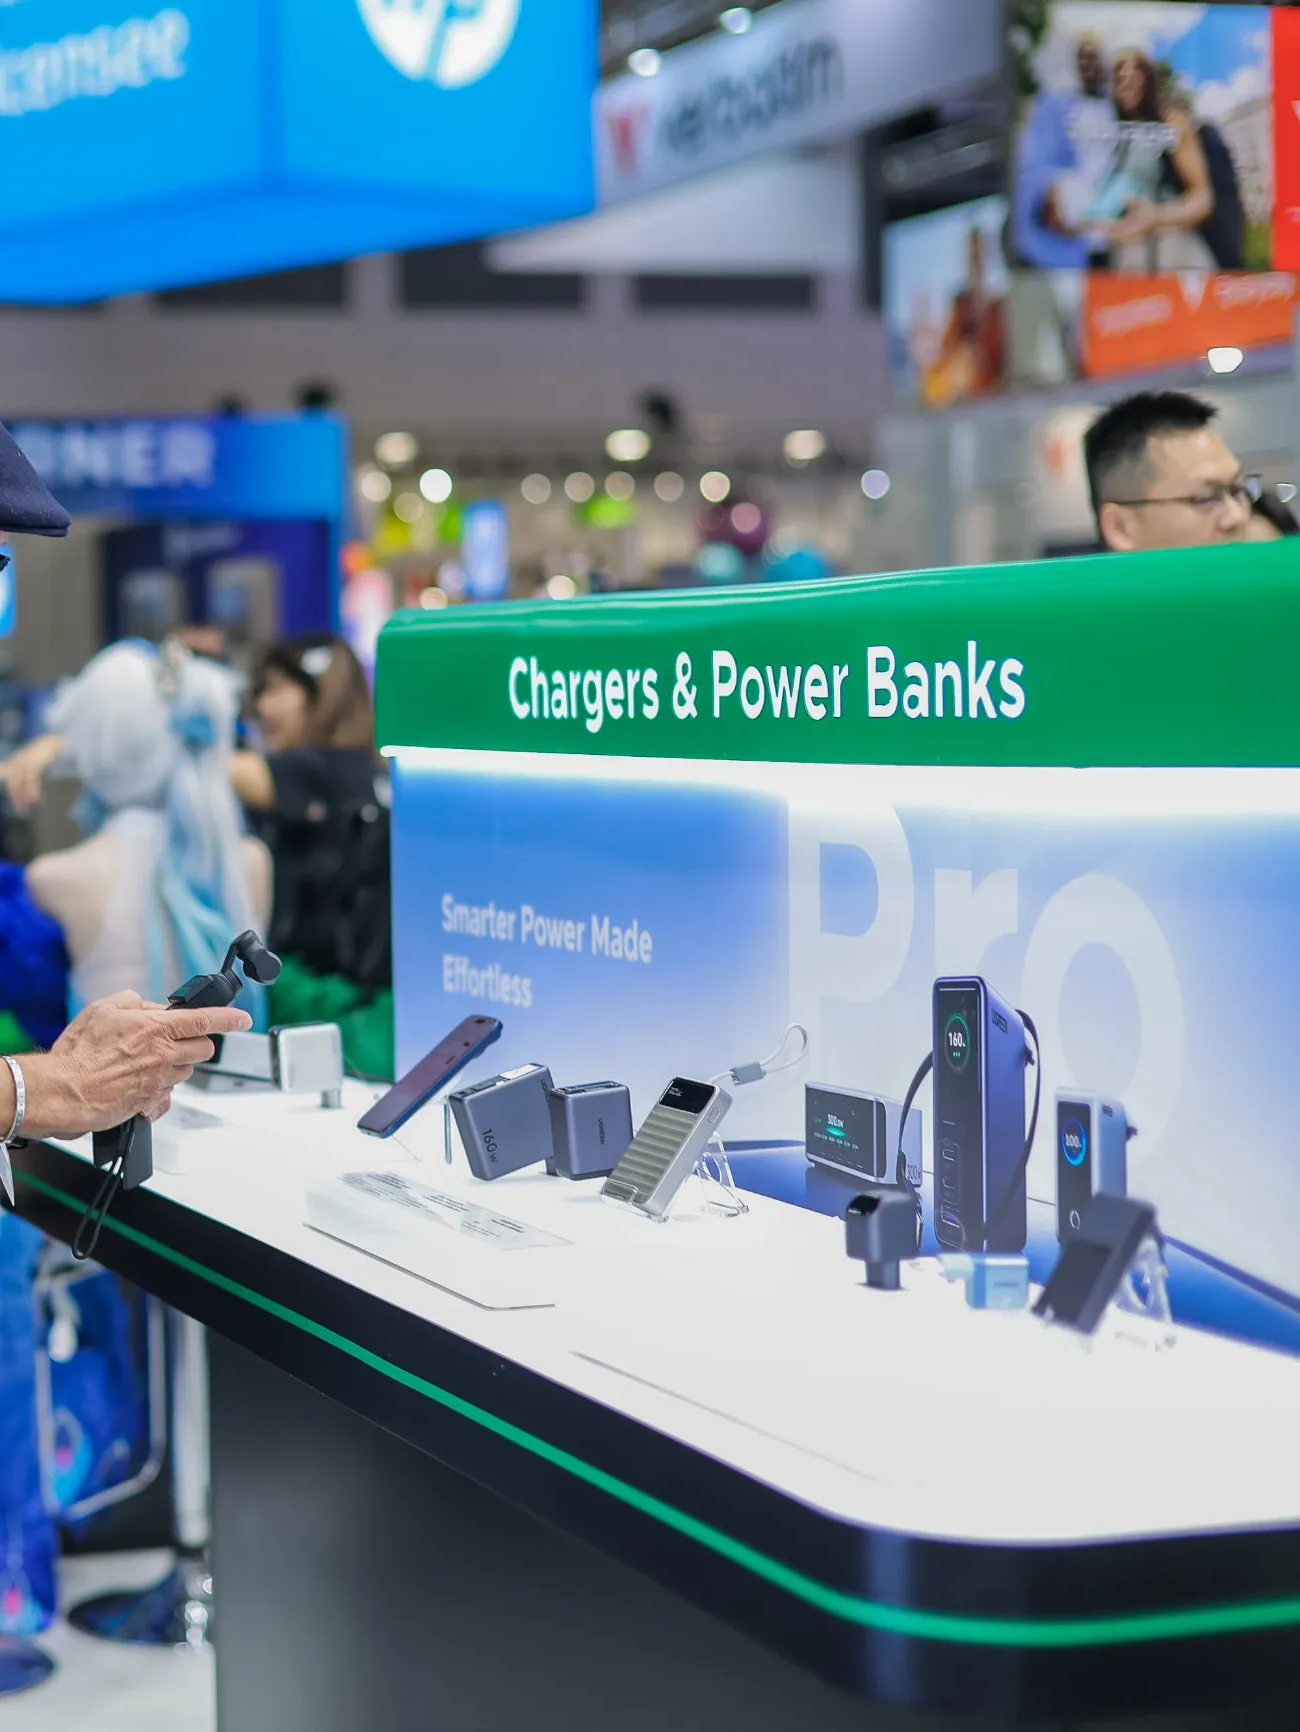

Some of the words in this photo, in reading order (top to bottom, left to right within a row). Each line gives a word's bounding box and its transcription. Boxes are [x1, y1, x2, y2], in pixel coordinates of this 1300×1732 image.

[508, 655, 660, 734] Chargers
[672, 650, 699, 720] &
[712, 648, 850, 721] Power
[866, 639, 1026, 719] Banks
[441, 893, 516, 941] Smarter
[521, 904, 585, 953] Power
[591, 914, 653, 964] Made
[442, 953, 533, 1008] Effortless
[788, 792, 1186, 1150] Pro
